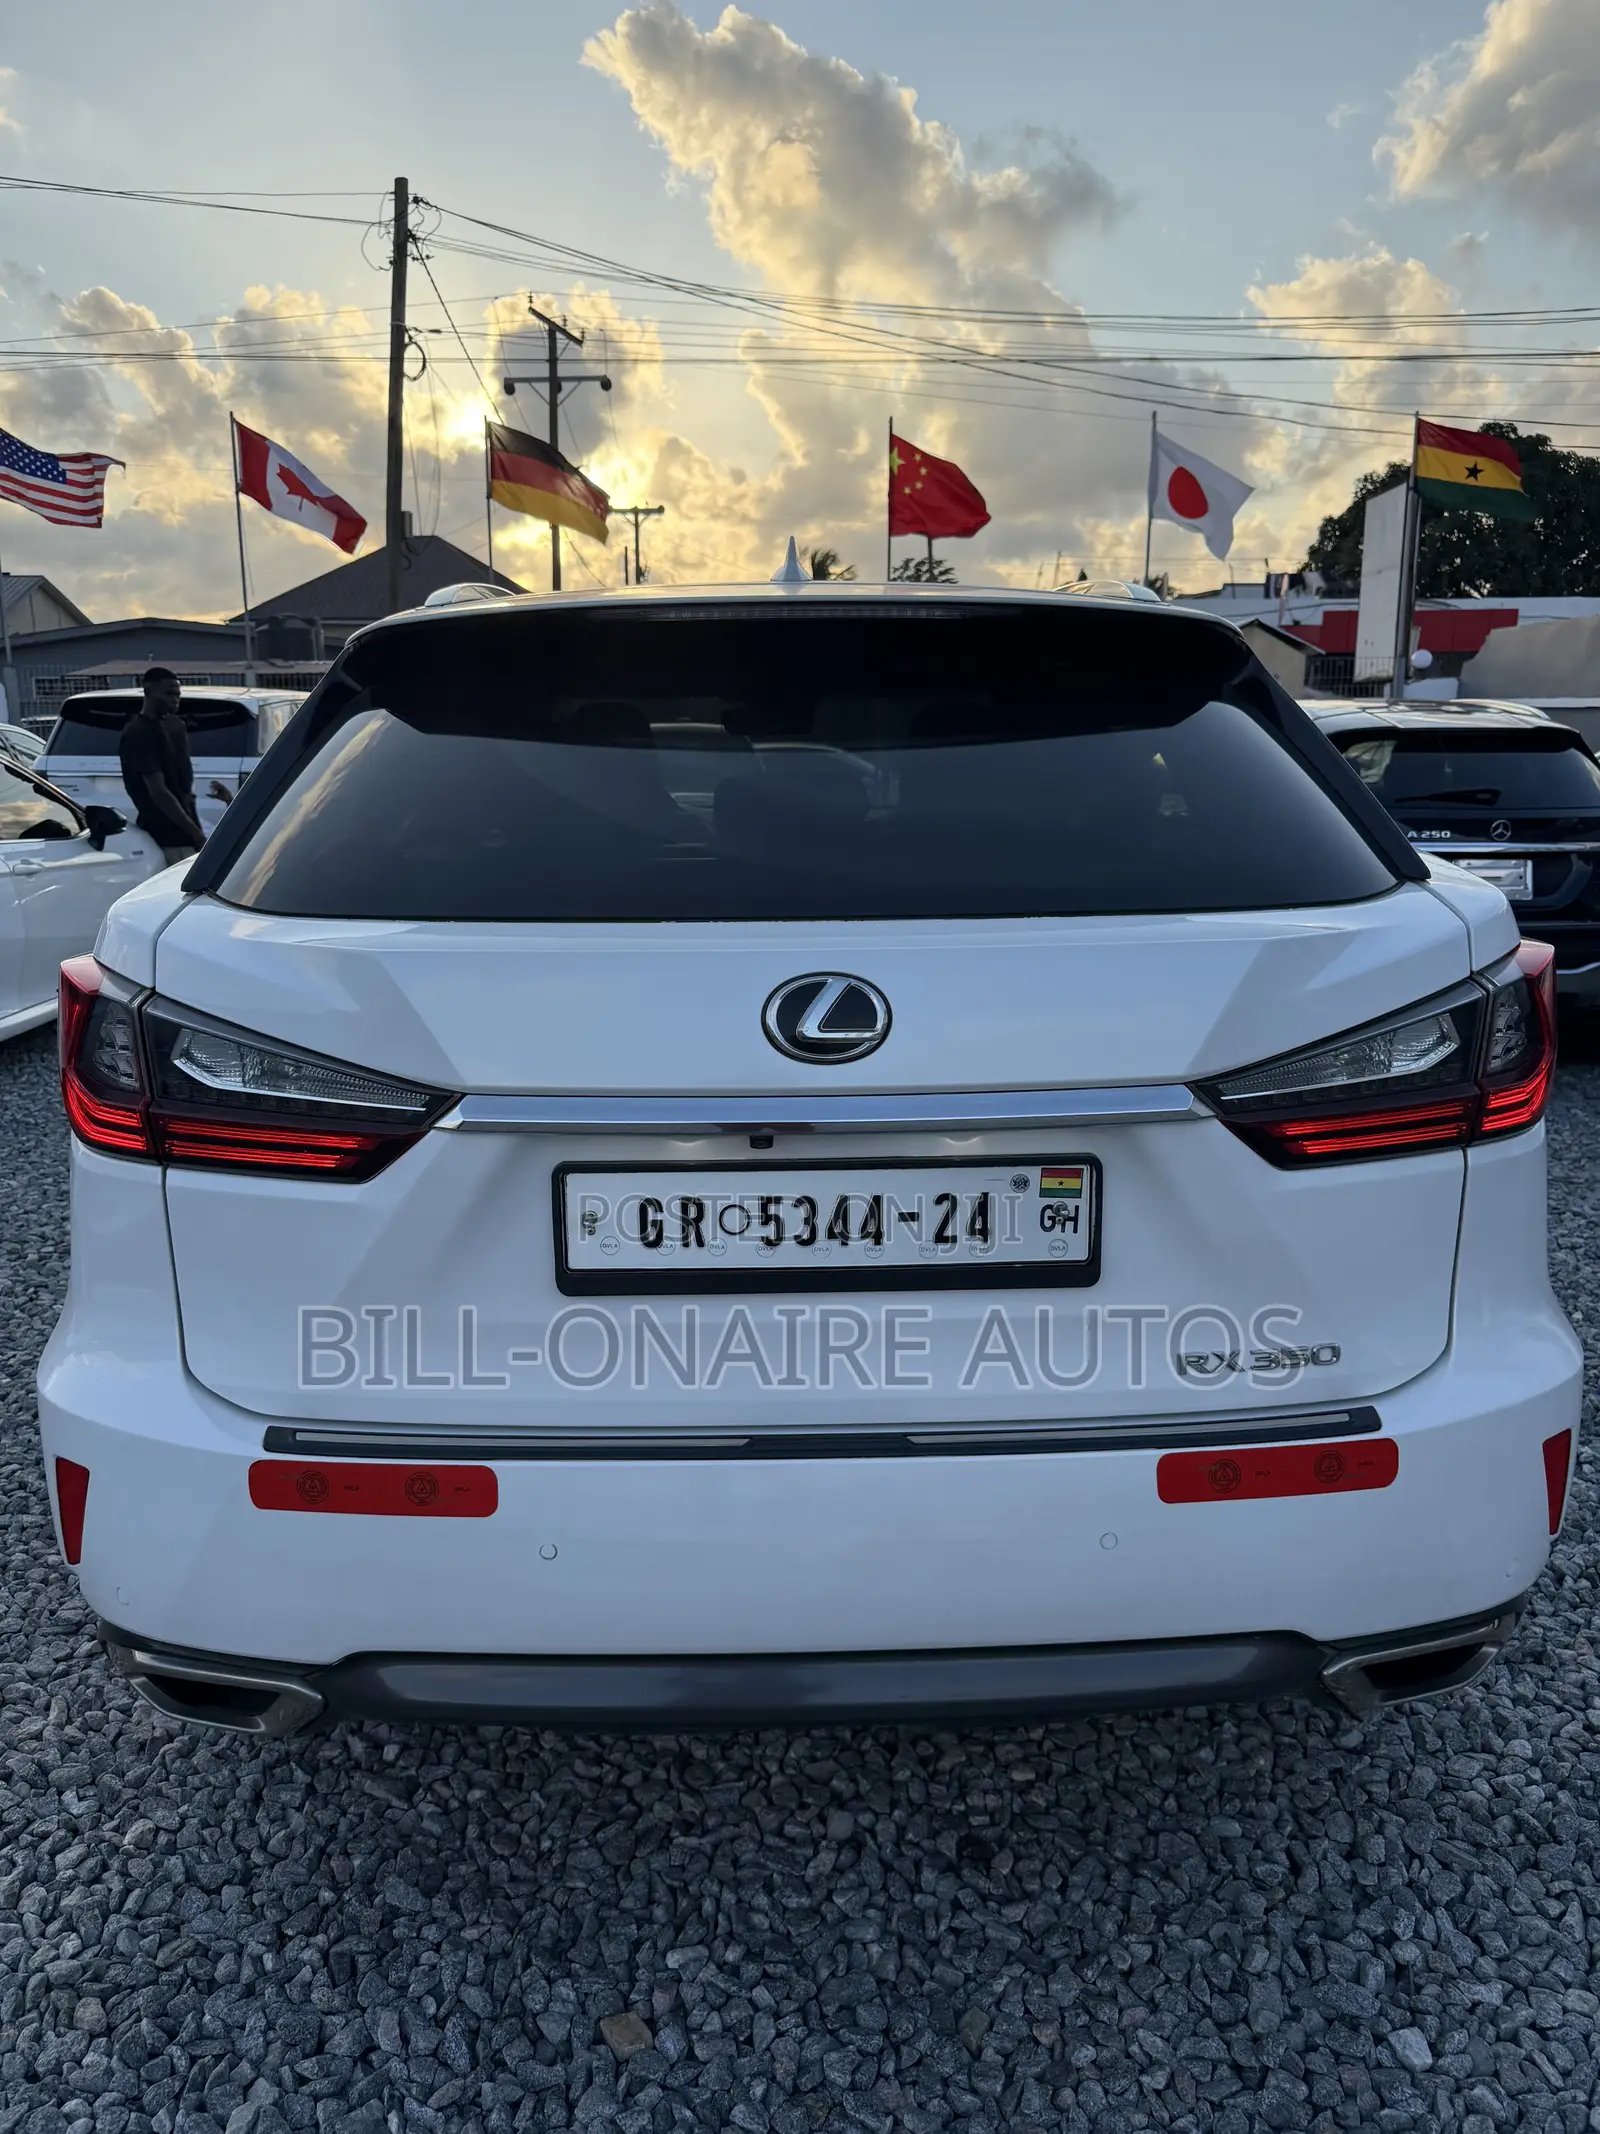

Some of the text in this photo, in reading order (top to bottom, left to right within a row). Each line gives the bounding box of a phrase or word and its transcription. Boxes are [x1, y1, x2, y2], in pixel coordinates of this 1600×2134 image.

[1407, 830, 1451, 839] A 250
[638, 1191, 991, 1249] GR 5344-24
[1039, 1203, 1080, 1234] GH
[1176, 1342, 1342, 1376] RX 350
